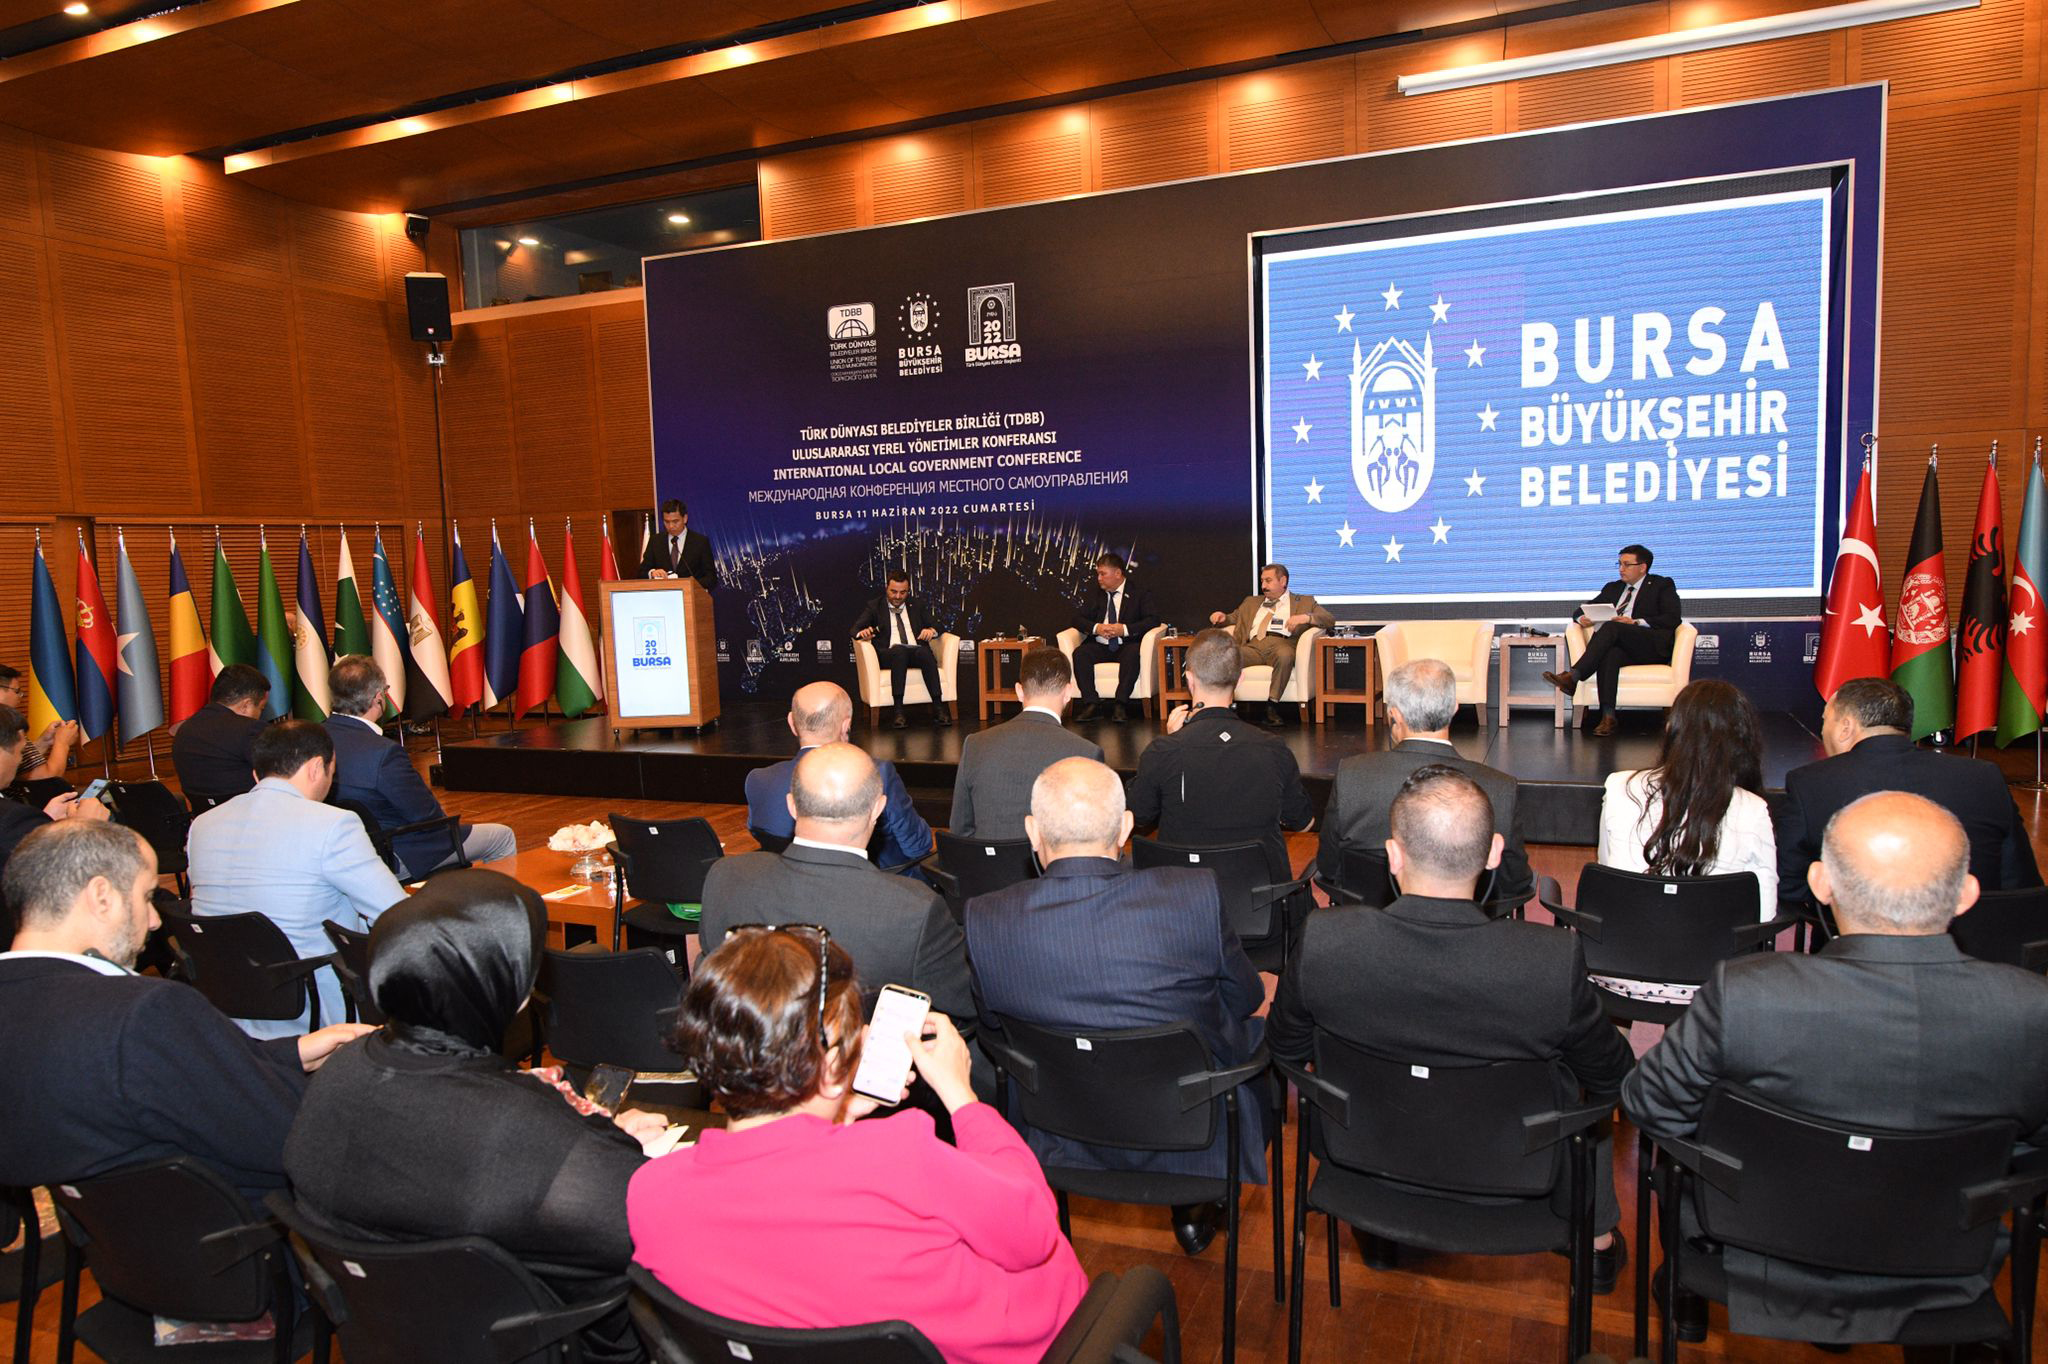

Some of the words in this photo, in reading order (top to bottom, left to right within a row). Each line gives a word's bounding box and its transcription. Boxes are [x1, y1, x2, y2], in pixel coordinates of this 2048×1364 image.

[840, 307, 862, 317] TDBB
[983, 320, 1001, 332] 20
[983, 332, 1002, 344] 22
[1521, 301, 1790, 388] BURSA
[829, 342, 847, 351] TÜRK
[848, 340, 877, 349] DÜNYASI
[899, 345, 942, 359] BURSA
[965, 343, 1021, 362] BURSA
[899, 356, 942, 368] BÜYÜKŞEHİR
[899, 365, 943, 377] BELEDİYESİ
[1521, 377, 1788, 448] BÜYÜKŞEHİR
[800, 426, 828, 441] TÜRK
[830, 424, 878, 439] DÜNYASI
[880, 418, 953, 436] BELEDİYELER
[956, 412, 1001, 430] BİRLİĞİ
[1004, 411, 1045, 429] (TDBB)
[792, 444, 870, 460] ULUSLARARASI
[872, 442, 906, 456] YEREL
[908, 436, 979, 453] YÖNETİMLER
[982, 431, 1057, 448] KONFERANSI
[773, 463, 867, 480] INTERNATIONAL
[869, 462, 906, 475] LOCAL
[909, 456, 994, 473] GOVERNMENT
[997, 450, 1082, 467] CONFERENCE
[1521, 440, 1788, 507] BELEDİYESİ
[748, 486, 847, 504] МЕЖДУНАРОДНАЯ
[850, 481, 936, 497] КОНФЕРЕНЦИЯ
[940, 477, 1005, 493] МЕСТНОГО
[1008, 470, 1129, 490] САМОУПРАВЛЕНИЯ
[816, 510, 852, 520] BURSA
[857, 510, 867, 518] 11
[872, 506, 926, 517] HAZİRAN
[931, 505, 959, 515] 2022
[963, 499, 1035, 514] CUMARTESİ
[645, 640, 656, 648] 20
[645, 648, 657, 656] 22
[632, 656, 671, 667] BURSA
